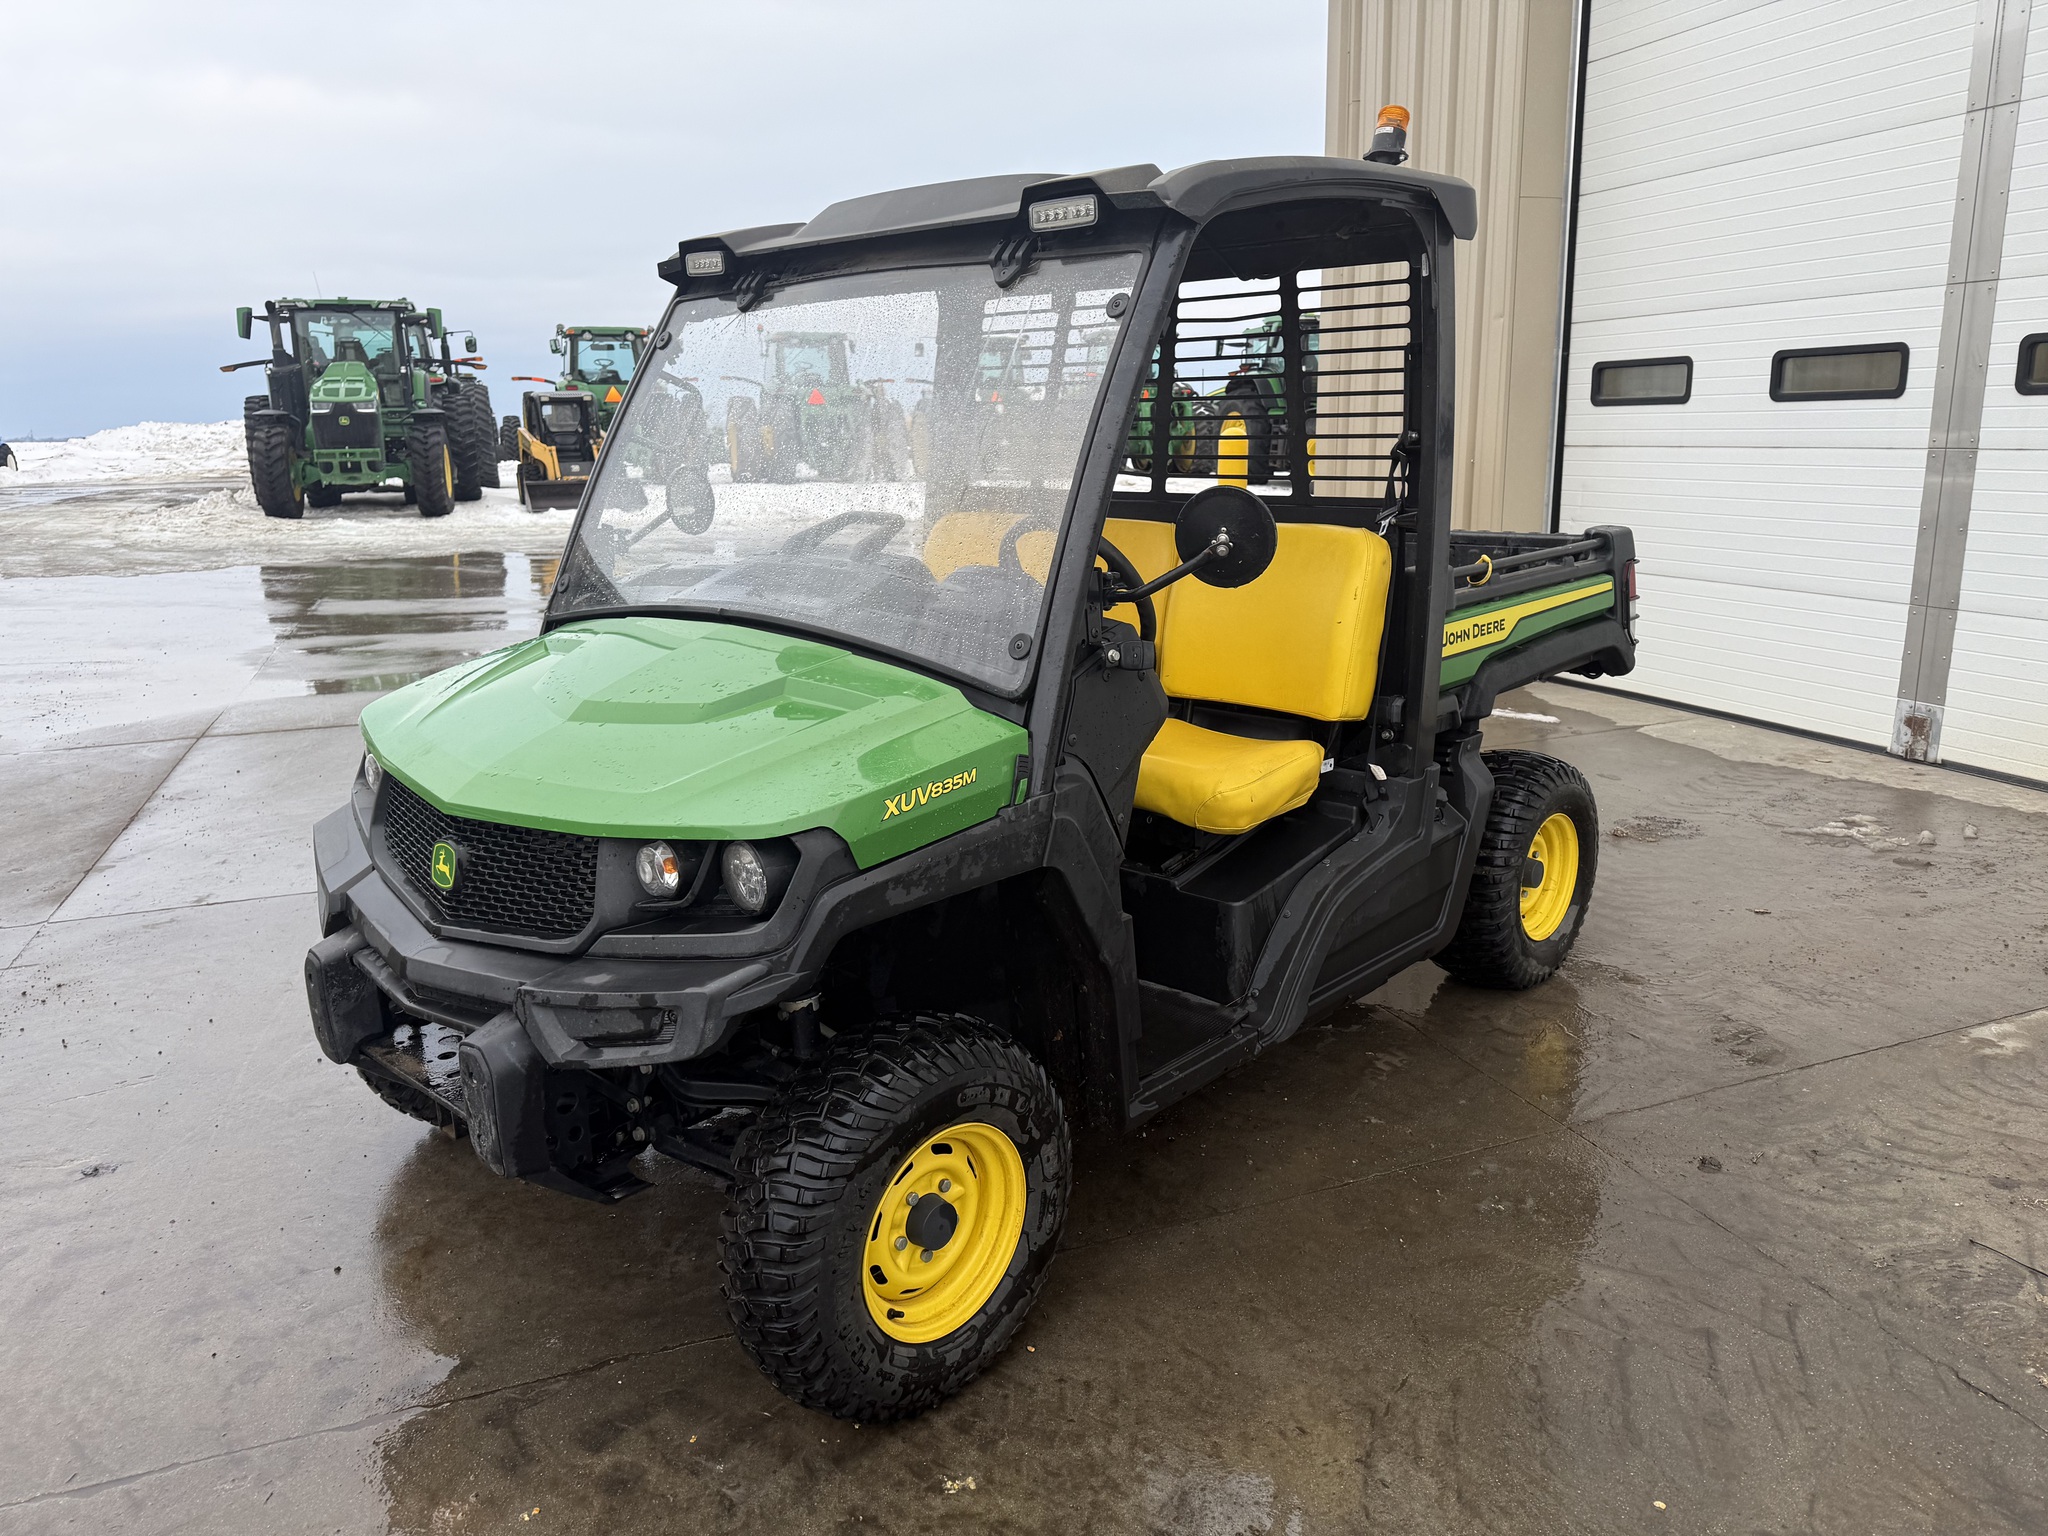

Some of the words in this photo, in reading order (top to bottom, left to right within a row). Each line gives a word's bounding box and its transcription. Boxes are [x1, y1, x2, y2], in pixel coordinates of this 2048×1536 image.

[1443, 628, 1470, 647] JOHN
[1473, 619, 1505, 639] DEERE
[881, 767, 977, 822] XUV835M
